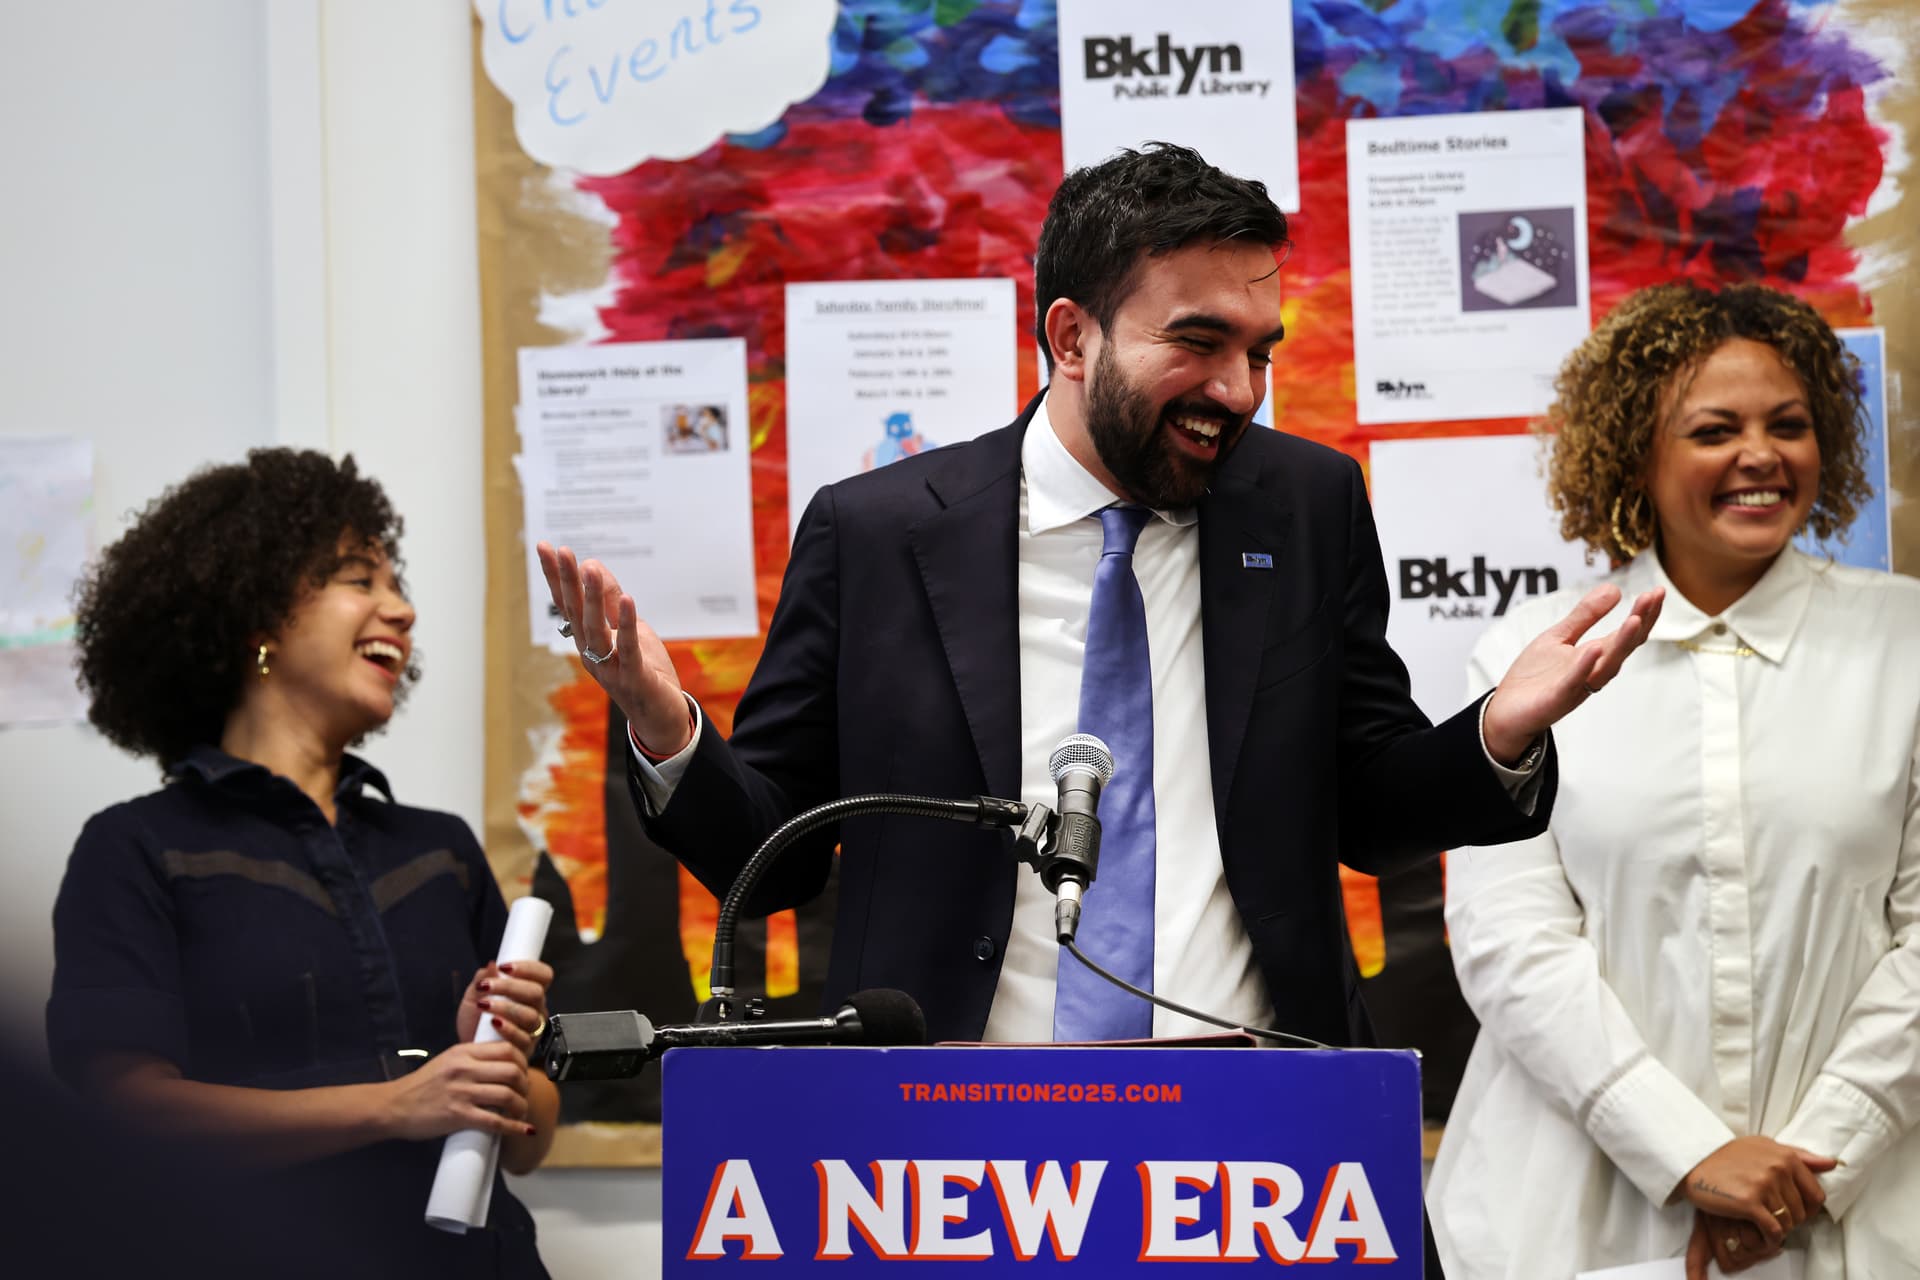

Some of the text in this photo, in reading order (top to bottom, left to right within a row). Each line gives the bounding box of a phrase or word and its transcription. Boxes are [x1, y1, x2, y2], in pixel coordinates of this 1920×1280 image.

[545, 0, 762, 126] Events
[1085, 33, 1242, 95] Bklyn
[1114, 78, 1269, 99] Public Library
[1368, 134, 1508, 157] Bedtime Stories
[1399, 556, 1558, 616] Bklyn
[1429, 604, 1484, 620] Public
[900, 1083, 1182, 1104] TRANSITION2025.COM
[686, 1158, 1400, 1265] A NEW ERA
